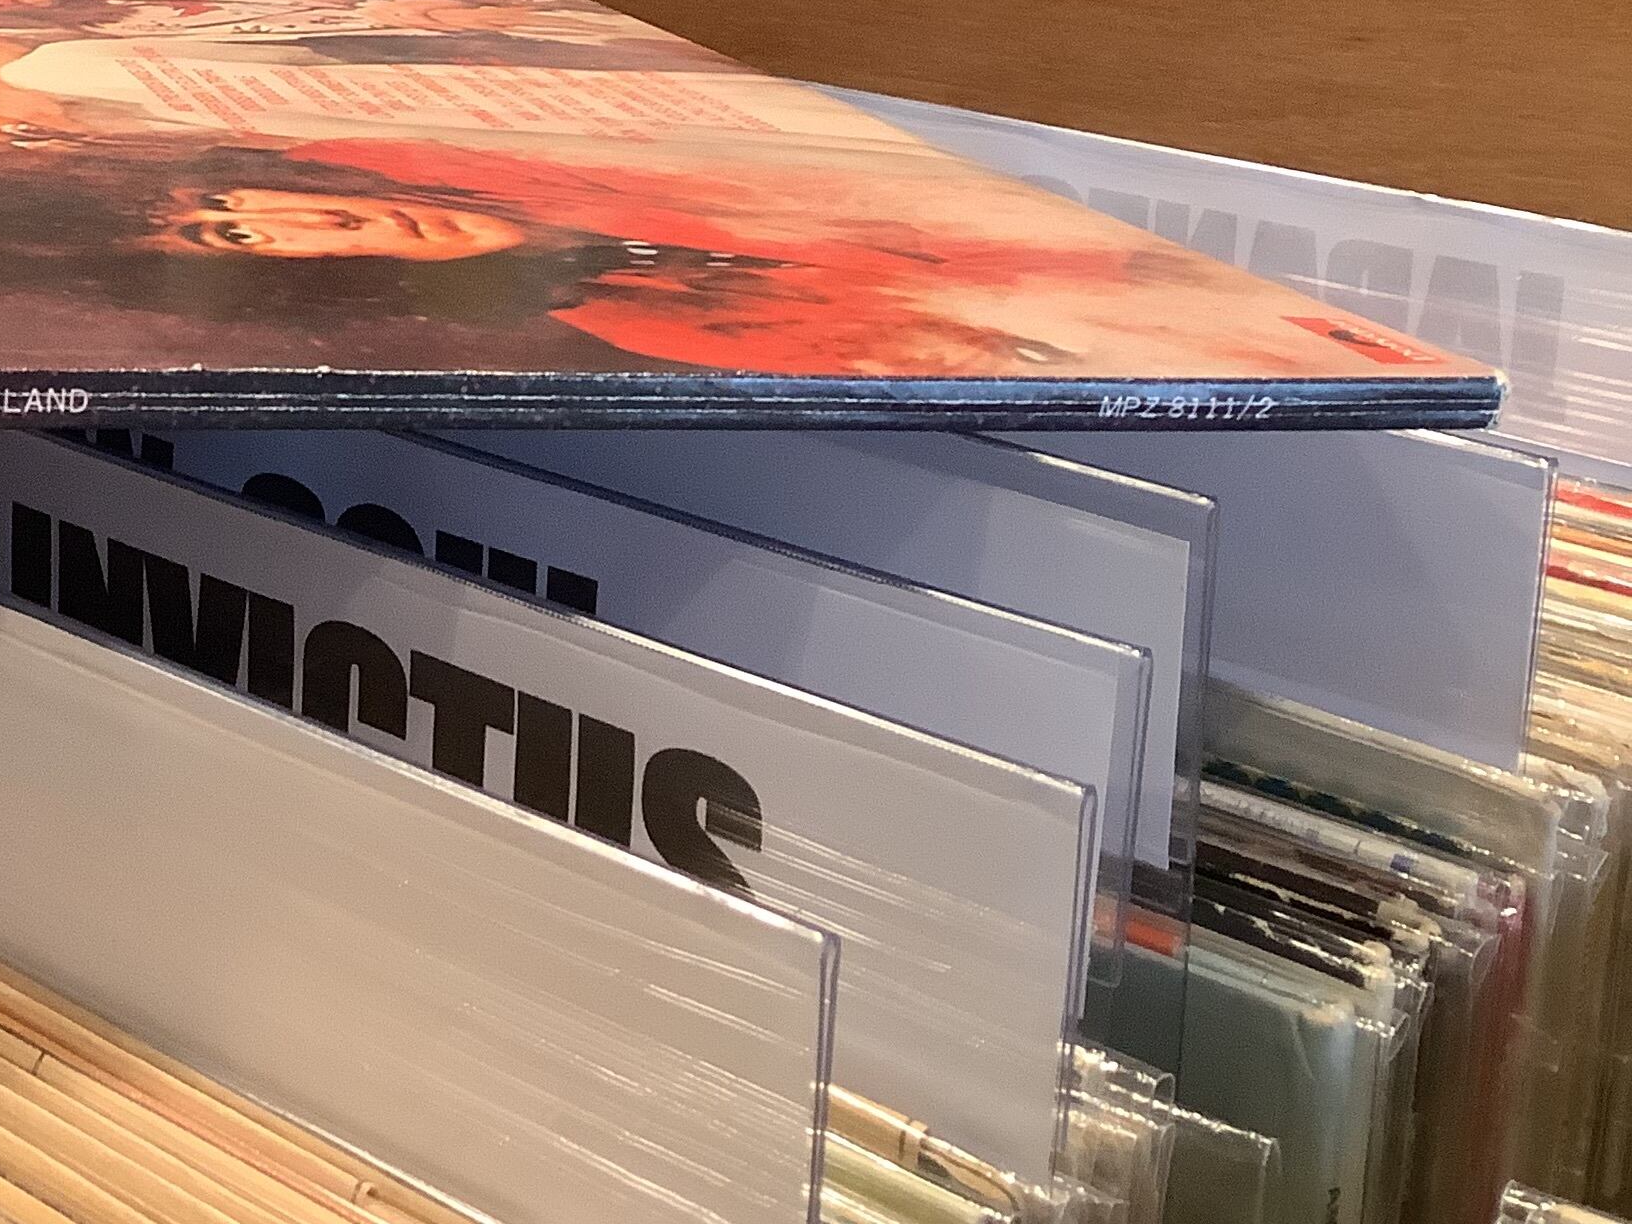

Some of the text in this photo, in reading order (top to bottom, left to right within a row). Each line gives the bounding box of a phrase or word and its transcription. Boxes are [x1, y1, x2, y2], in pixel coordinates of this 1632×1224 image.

[2, 386, 90, 415] LAND
[1098, 393, 1275, 421] MPZ 8111/2
